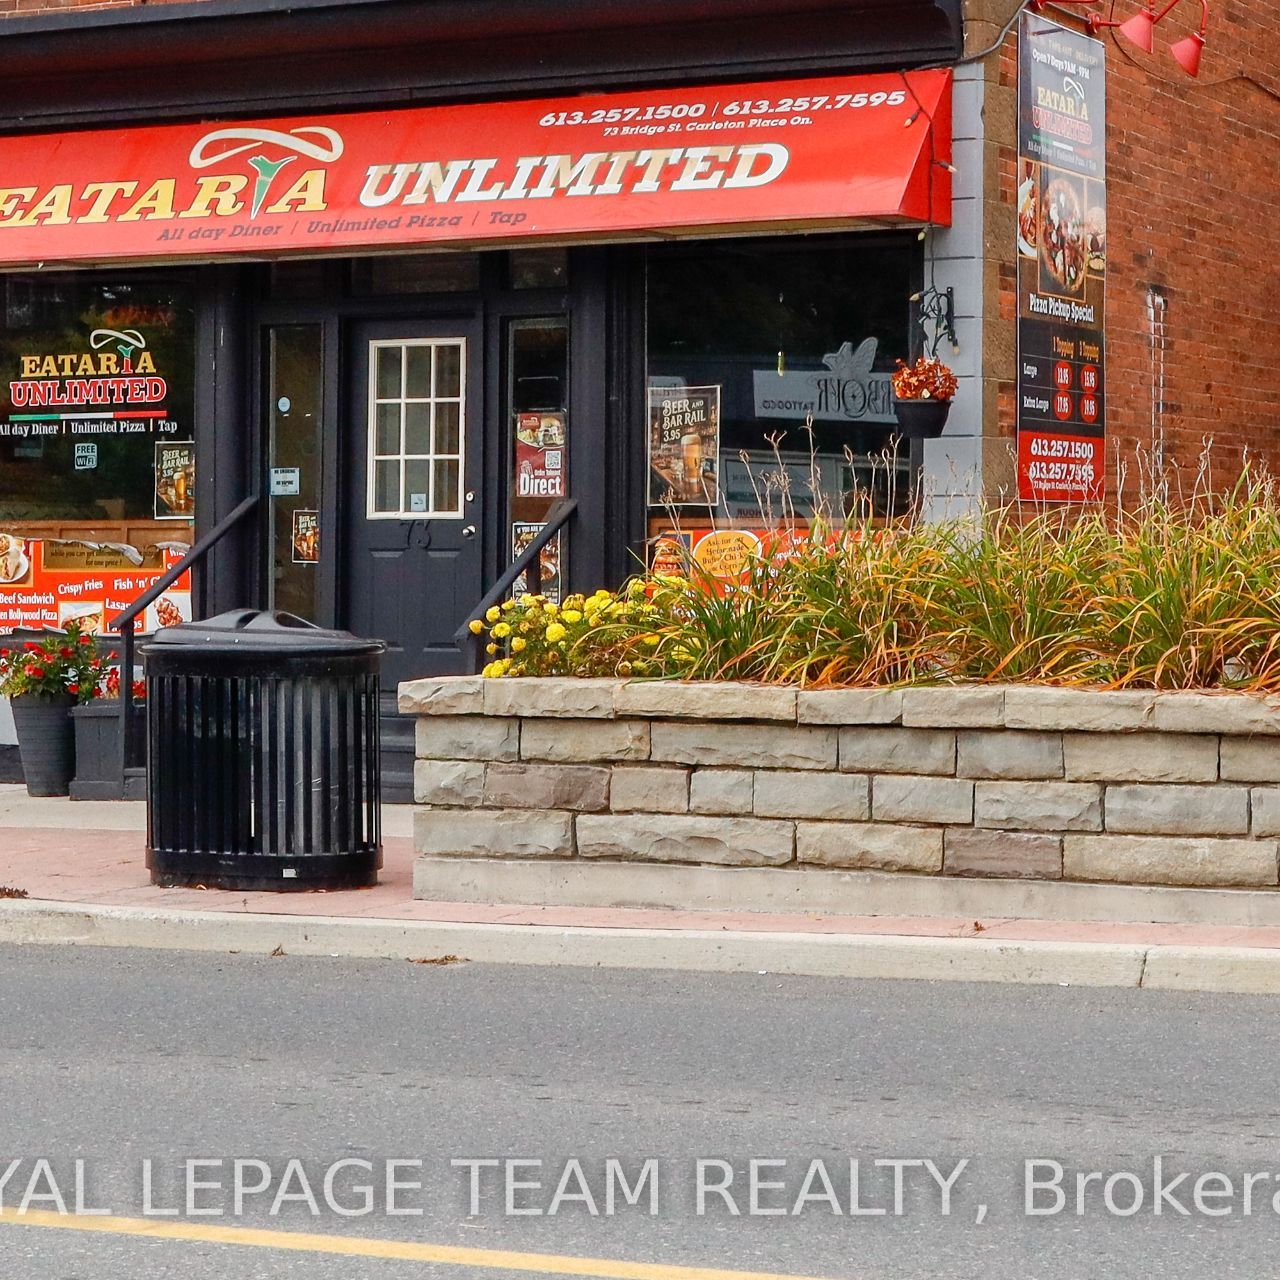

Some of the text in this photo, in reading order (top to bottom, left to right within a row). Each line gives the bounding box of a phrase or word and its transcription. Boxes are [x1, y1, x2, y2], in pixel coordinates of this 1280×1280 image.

[539, 103, 706, 127] 613.257.1500
[722, 91, 907, 116] 613.257.7595
[603, 127, 619, 137] 73
[621, 123, 665, 136] Bridge
[685, 119, 746, 131] Carleton
[748, 117, 789, 128] Place
[791, 115, 813, 125] On.
[1032, 105, 1093, 145] UNLIMITED
[359, 143, 791, 208] UNLIMITED
[157, 228, 183, 241] All
[188, 226, 225, 241] day
[229, 223, 283, 238] Diner
[307, 217, 402, 234] Unlimited
[408, 213, 462, 228] Pizza
[489, 211, 527, 226] Tap
[1029, 292, 1094, 323] Pizza Pickup Special
[9, 377, 167, 407] UNLIMITED
[662, 399, 704, 416] BEER AND
[12, 424, 29, 438] day
[31, 422, 59, 436] Diner
[70, 421, 117, 434] Unlimited
[120, 421, 146, 433] Pizza
[158, 420, 178, 434] Tap
[662, 409, 707, 430] BAR RAIL
[663, 429, 680, 442] 3.95
[76, 445, 95, 454] FREE
[162, 450, 180, 461] BEER
[1031, 438, 1094, 459] 613.257.1500
[162, 456, 190, 470] BAR RAIL
[1029, 461, 1094, 481] 613.257.7595
[520, 474, 561, 495] Direct
[58, 583, 83, 596] Crispy
[84, 579, 103, 592] Fries
[113, 578, 133, 590] Fish
[0, 593, 16, 604] Beef
[17, 592, 55, 604] Sandwich
[105, 598, 132, 611] Lasa
[41, 608, 58, 620] Pizza
